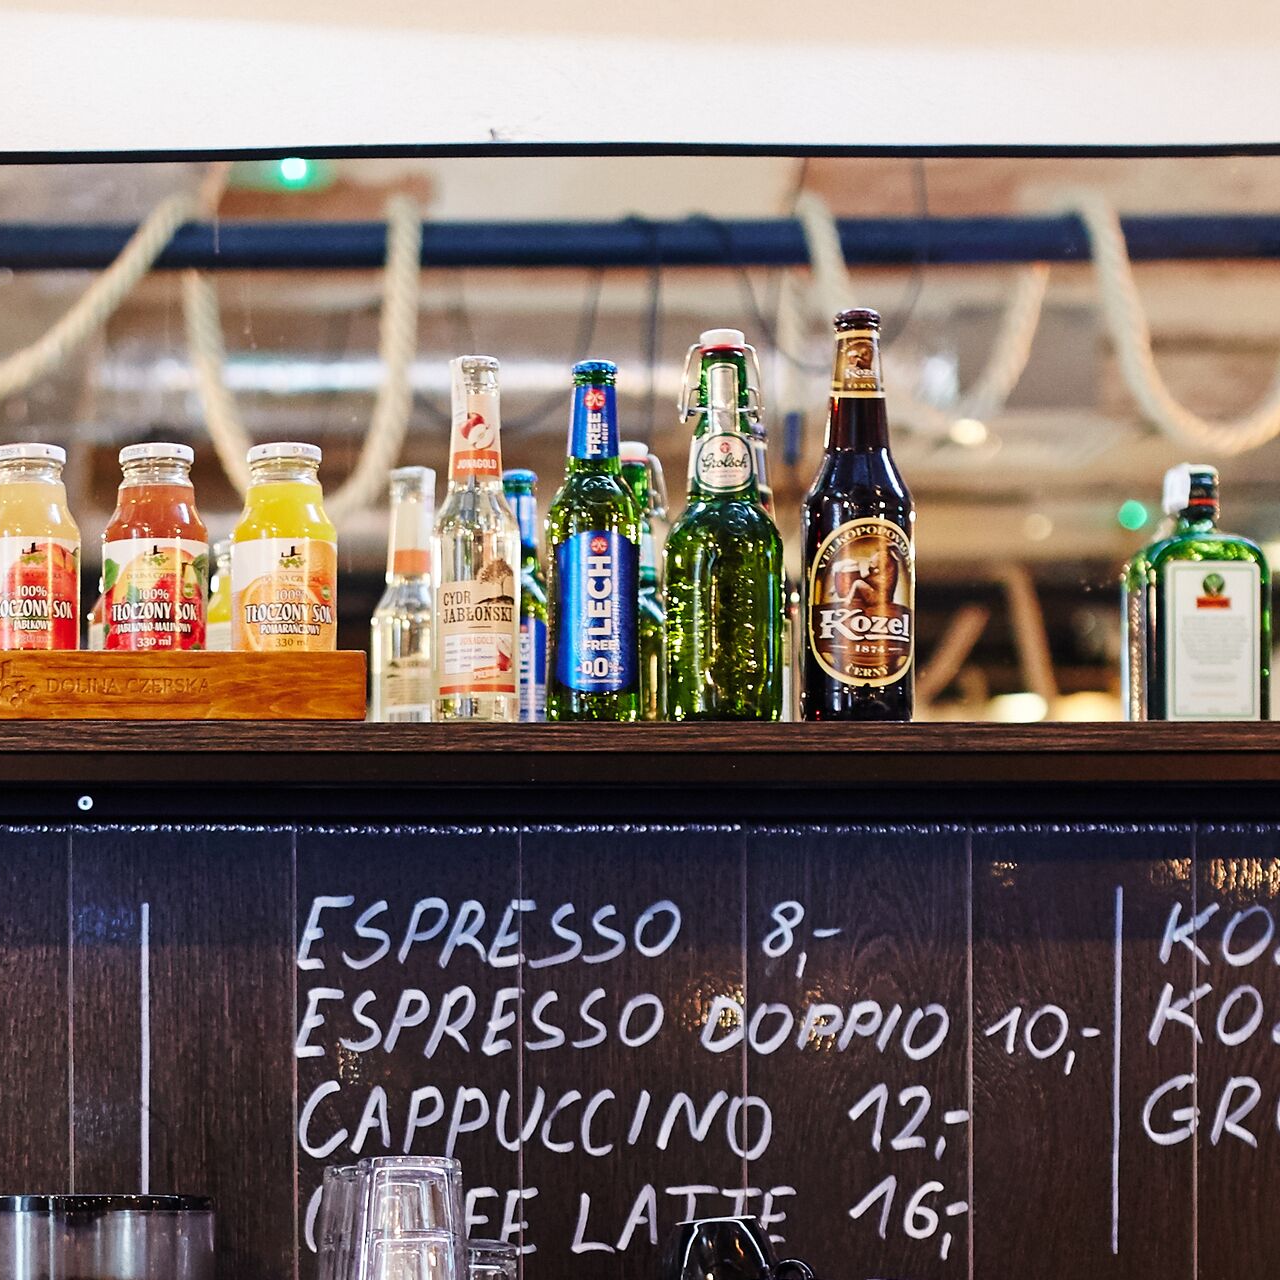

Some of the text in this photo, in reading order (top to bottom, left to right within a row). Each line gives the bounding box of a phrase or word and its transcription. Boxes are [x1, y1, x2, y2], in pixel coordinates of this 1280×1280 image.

[587, 413, 602, 454] FREE
[701, 452, 748, 473] Grolsch
[16, 585, 48, 597] 100%
[139, 588, 170, 600] 100%
[443, 590, 471, 606] CYDR
[587, 555, 613, 637] LECH
[52, 600, 74, 619] SOK
[112, 602, 197, 621] TŁOCZONY SOK
[245, 602, 333, 624] TŁOCZONY SOK
[443, 603, 513, 625] JABŁOŃSKI
[819, 608, 910, 642] Kozel
[136, 636, 172, 647] 330 ml
[275, 638, 294, 647] 330
[583, 639, 616, 651] FREE
[854, 644, 886, 653] 1874
[46, 677, 210, 695] DOLINA CZERSKA
[297, 895, 682, 970] ESPRESSO
[293, 984, 665, 1060] ESPRESSO
[700, 993, 951, 1062] DOPPIO
[298, 1080, 773, 1161] CAPPUCCINO
[570, 1183, 798, 1256] LATTE
